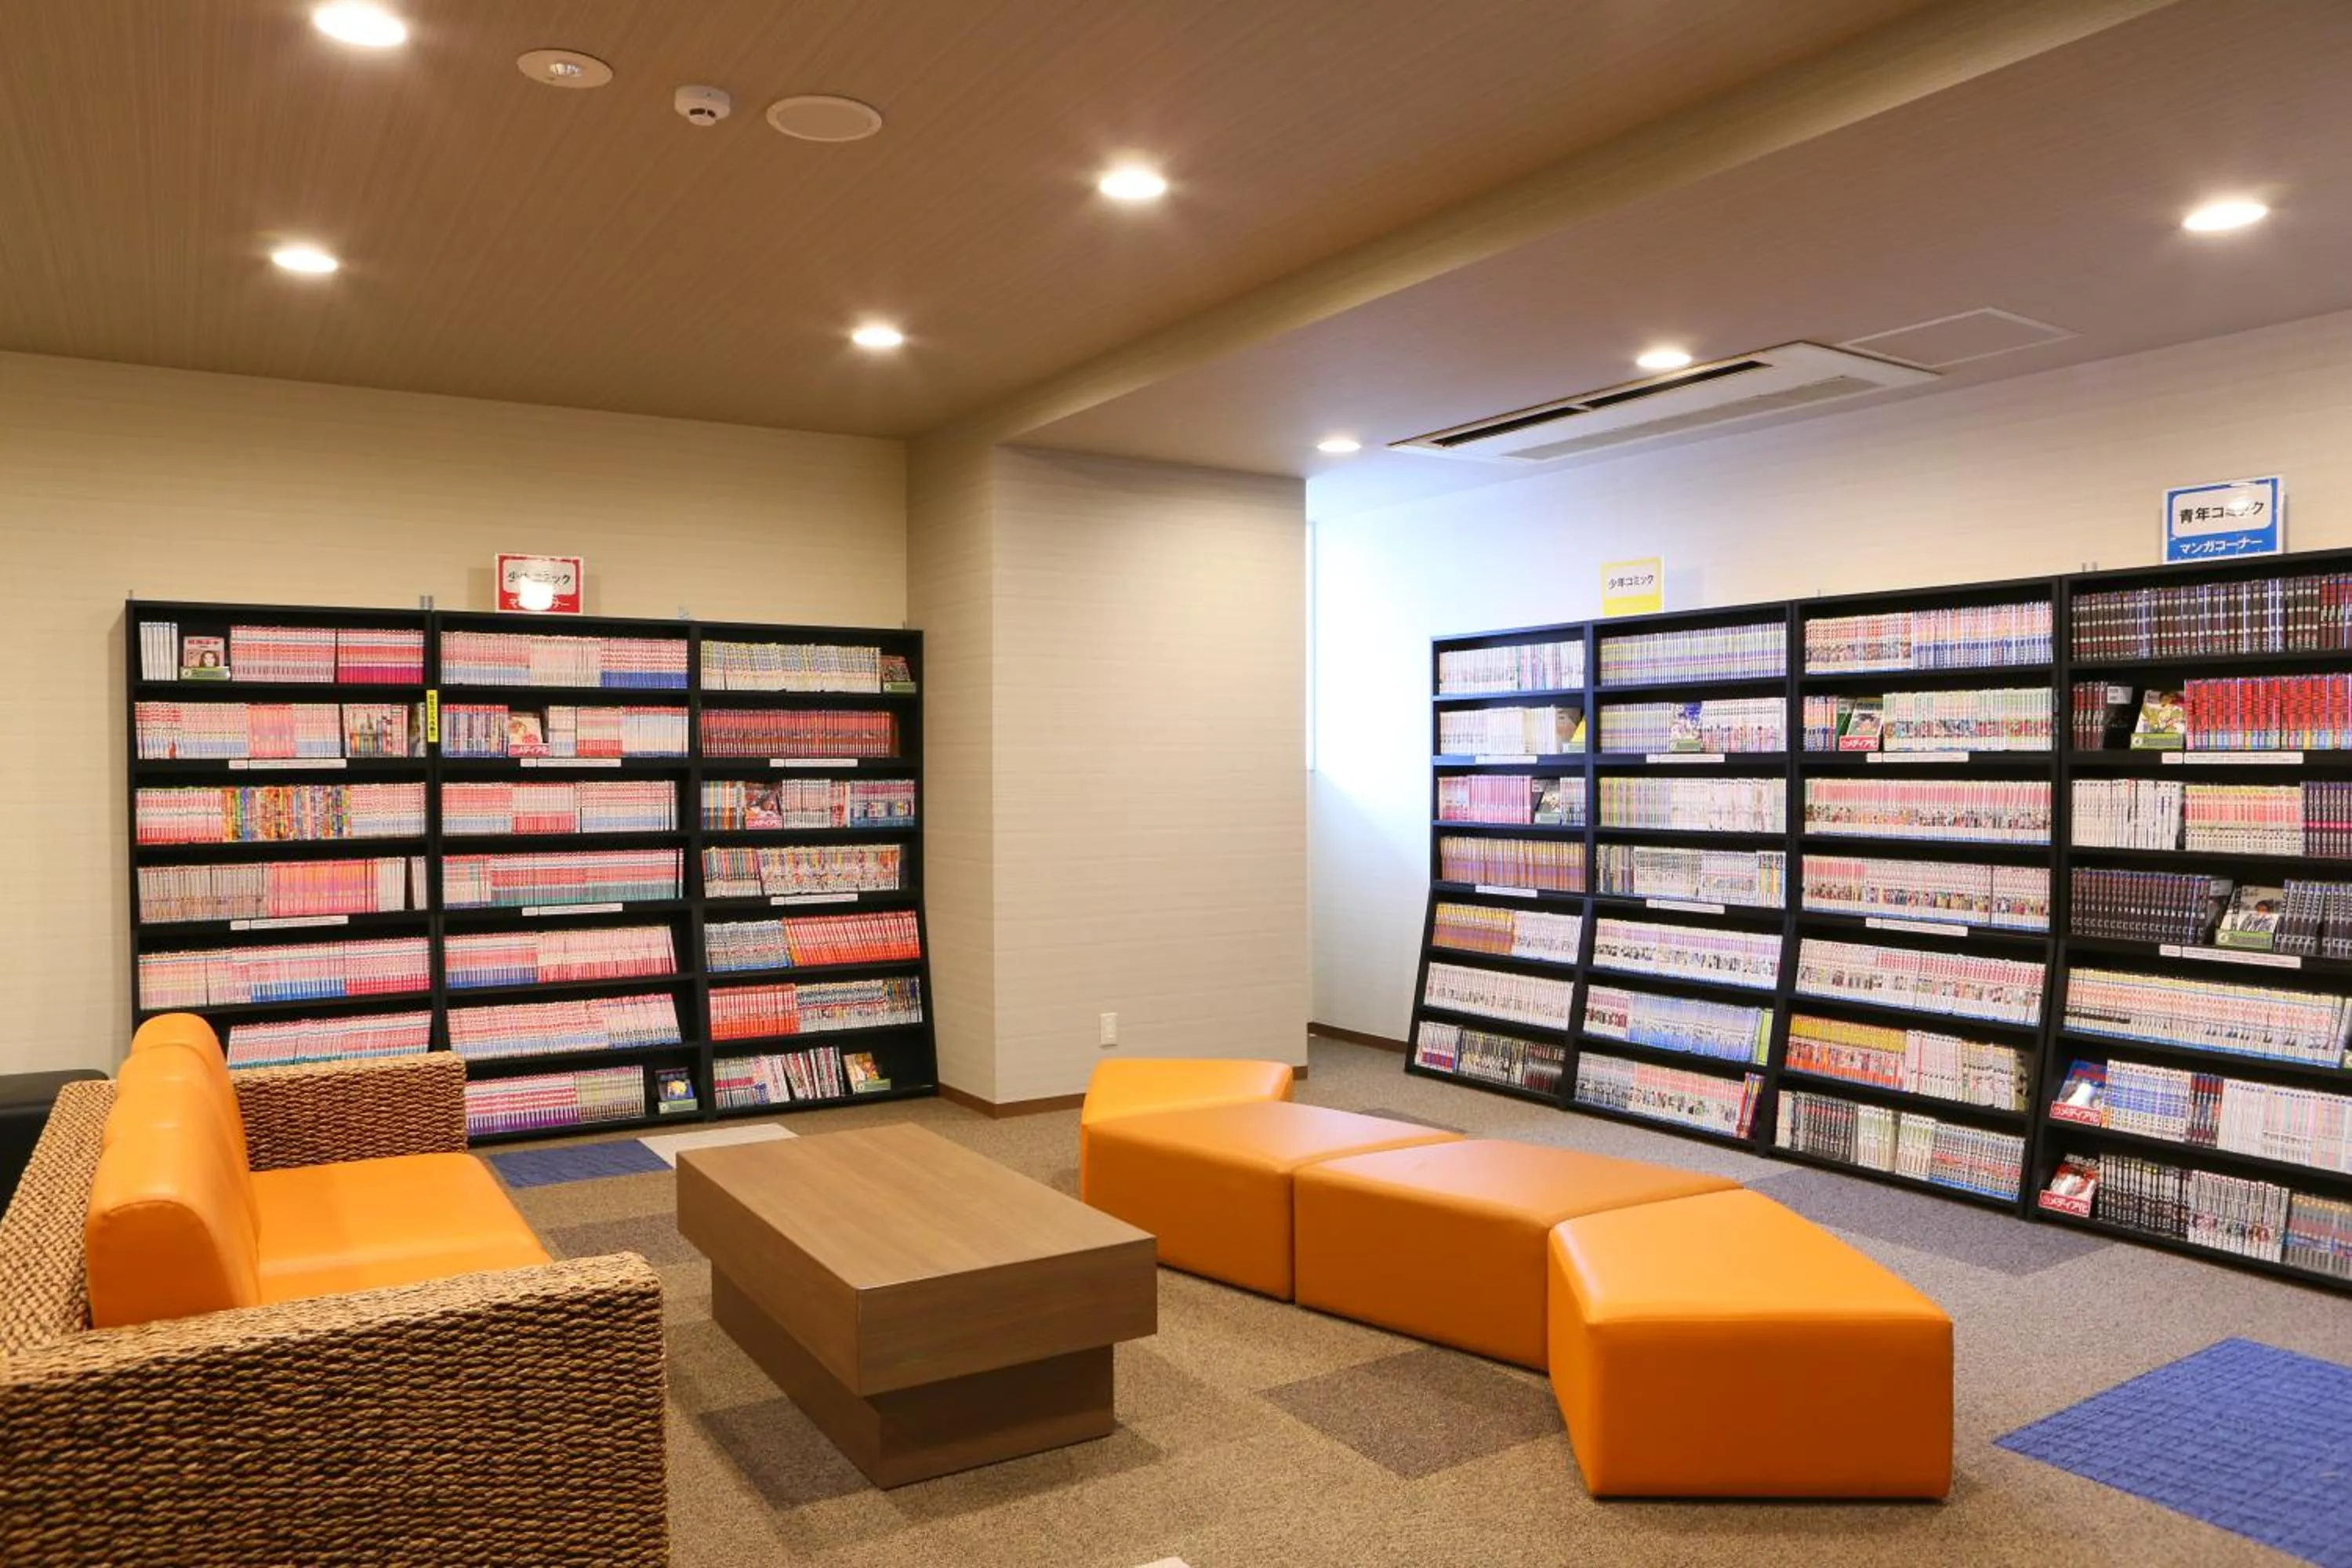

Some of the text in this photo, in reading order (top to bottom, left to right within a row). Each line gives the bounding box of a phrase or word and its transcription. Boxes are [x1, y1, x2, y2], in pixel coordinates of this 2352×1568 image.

[2180, 536, 2263, 554] マンガコーナー
[1608, 575, 1654, 590] 少年コミック
